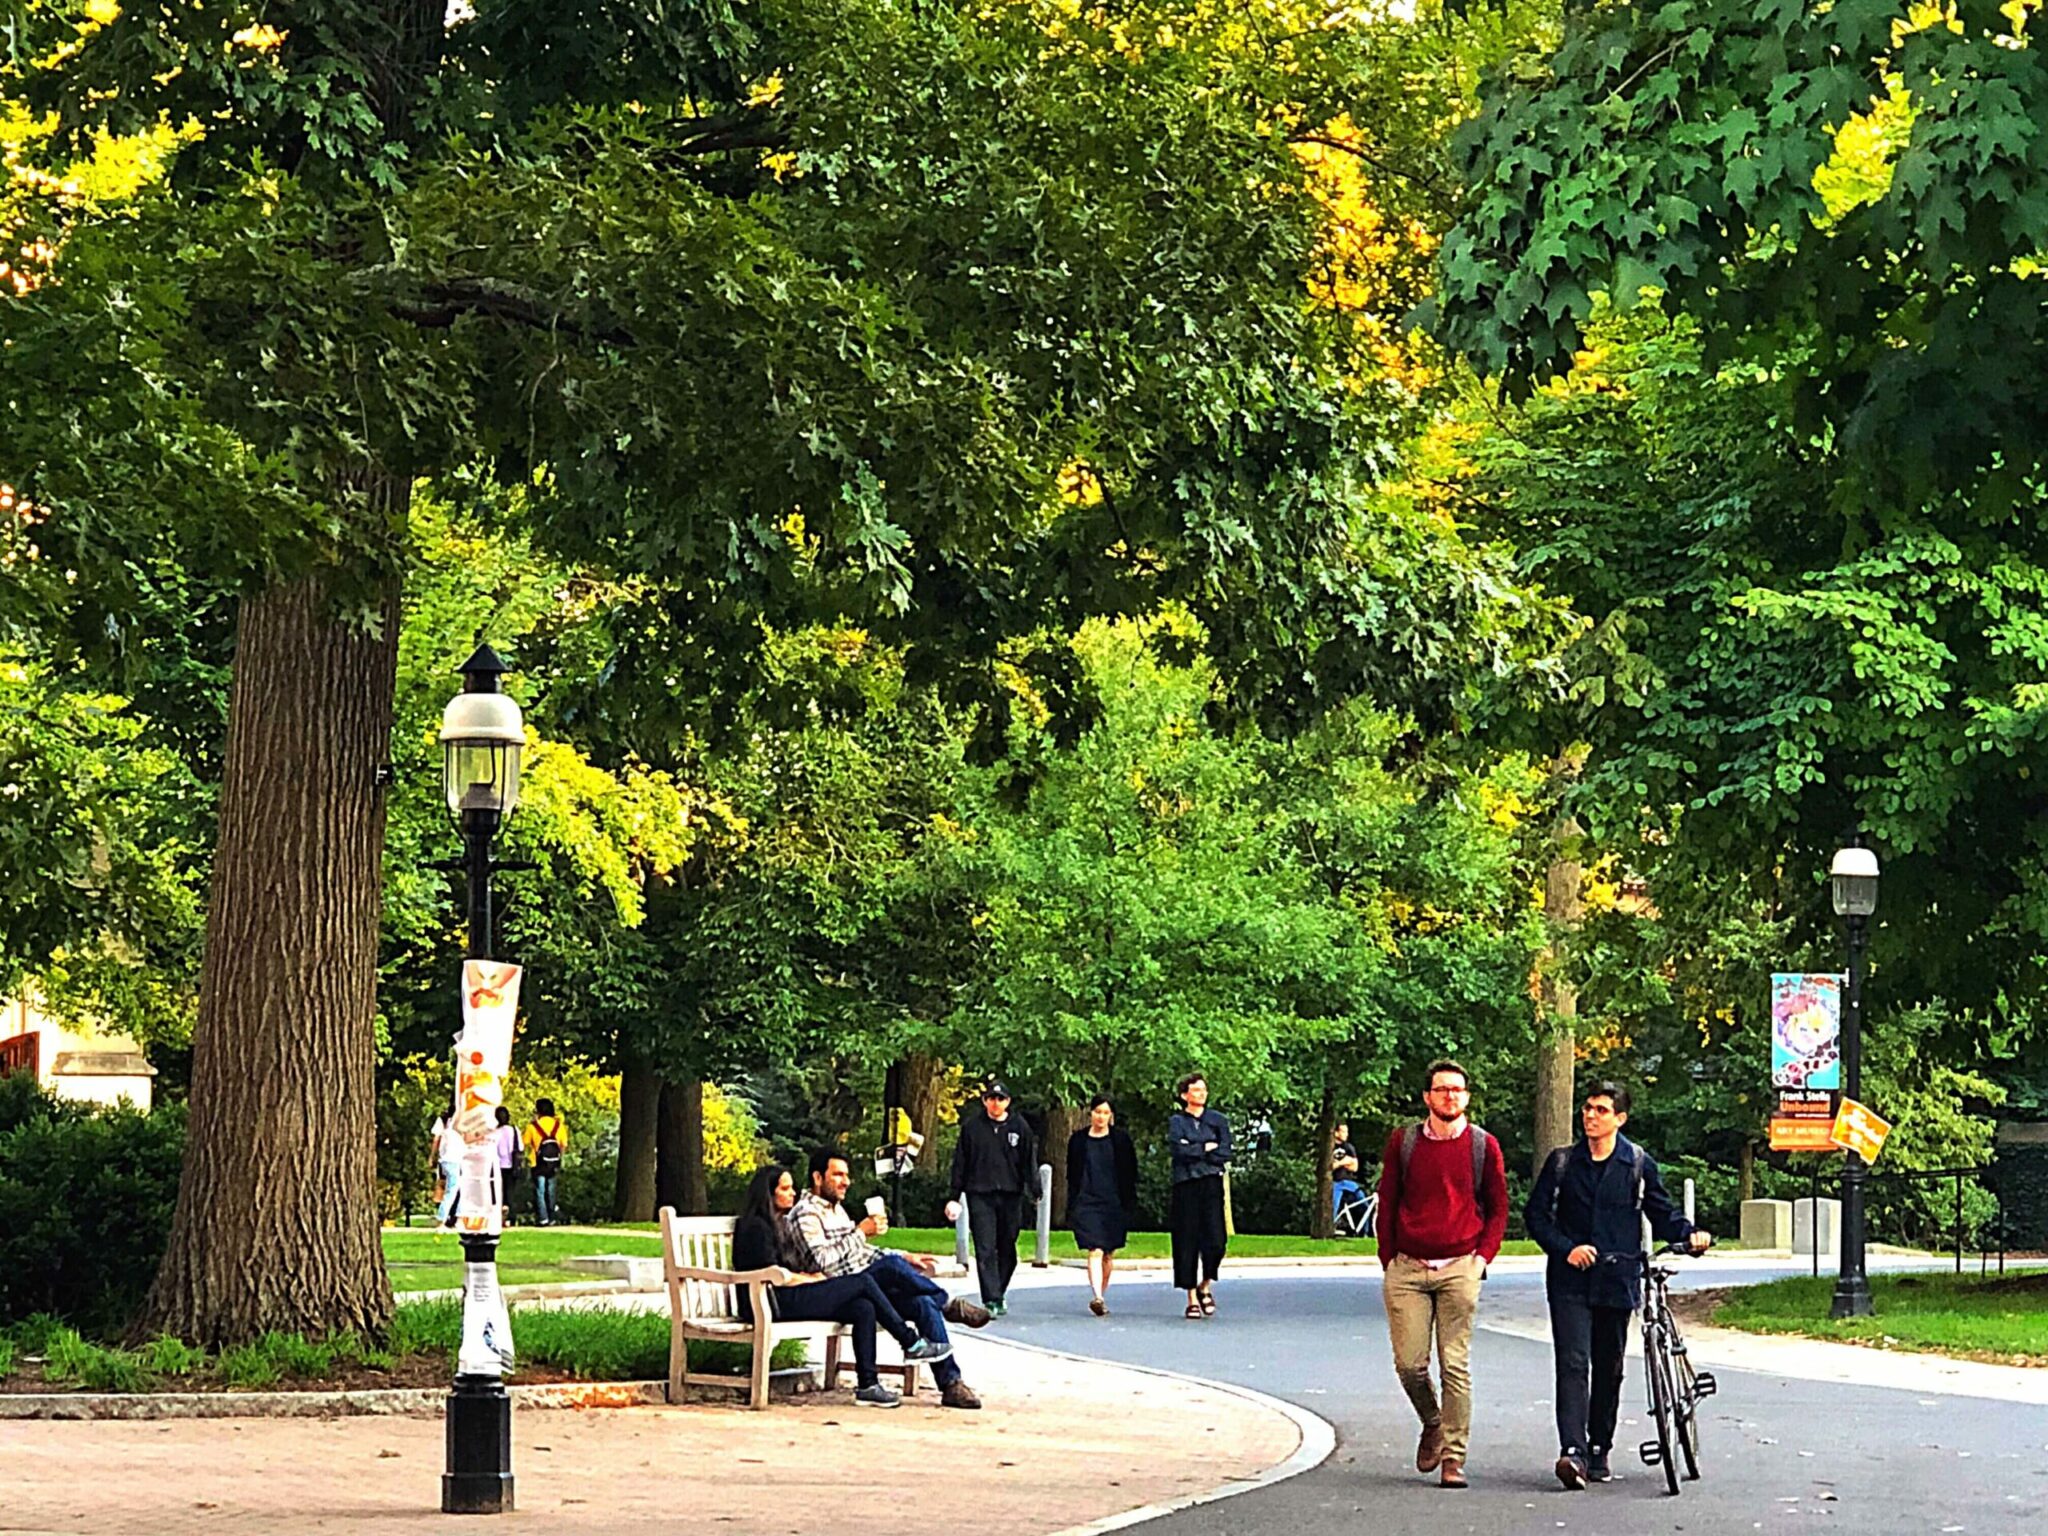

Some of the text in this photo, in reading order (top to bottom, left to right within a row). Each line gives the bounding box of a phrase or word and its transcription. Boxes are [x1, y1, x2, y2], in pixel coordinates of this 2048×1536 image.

[1780, 1091, 1830, 1101] Frank Stella
[1780, 1101, 1830, 1112] Unbound
